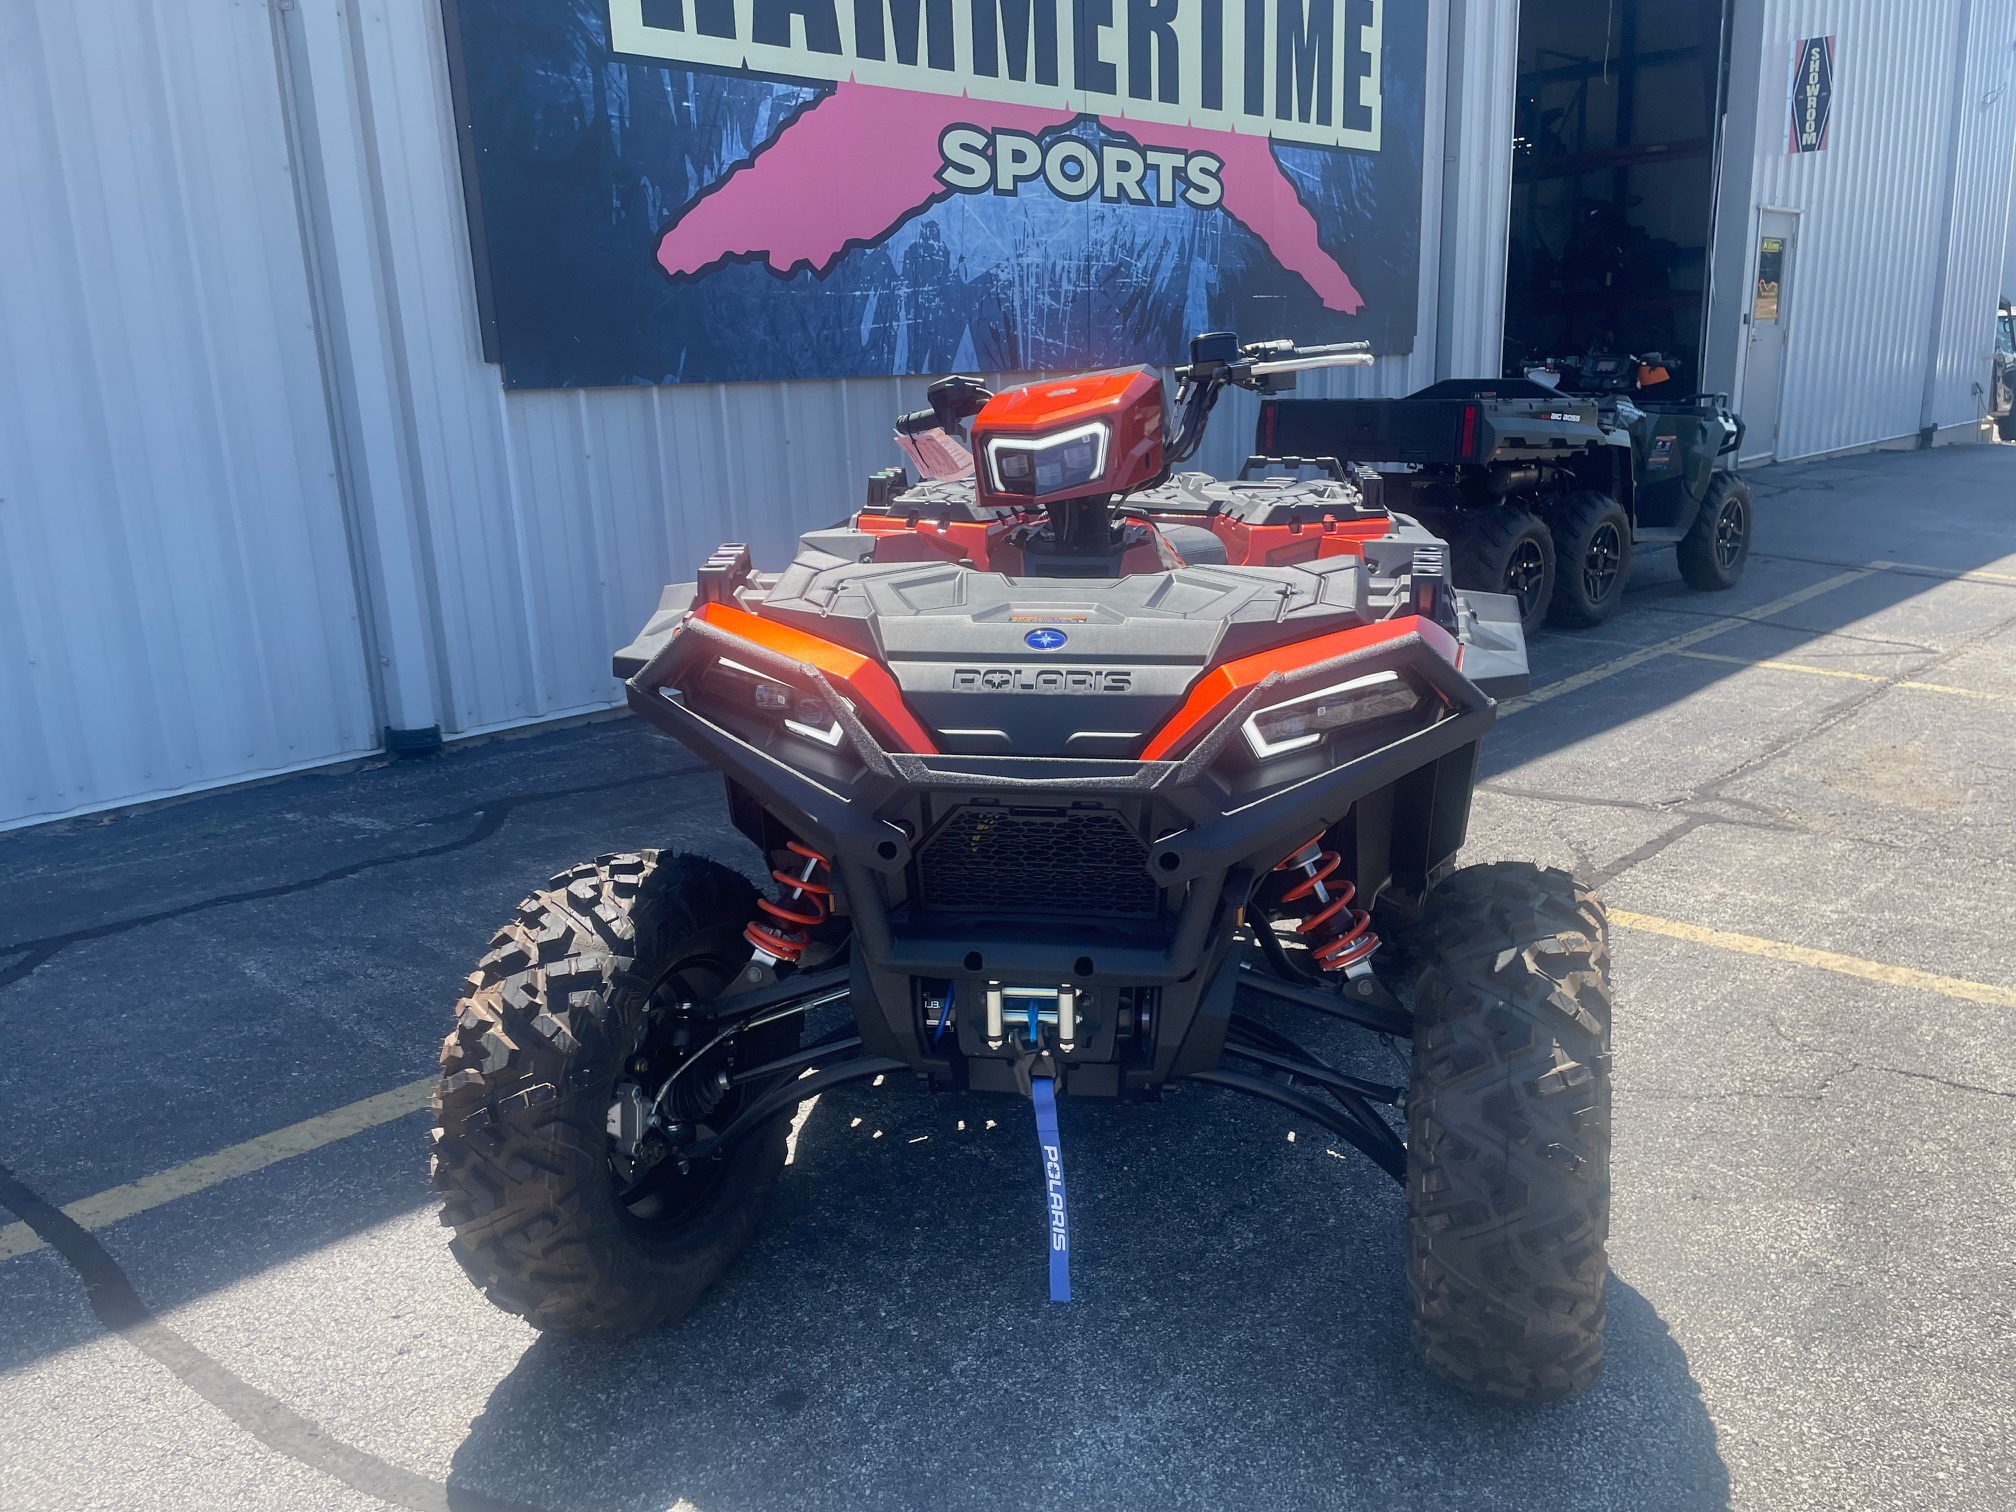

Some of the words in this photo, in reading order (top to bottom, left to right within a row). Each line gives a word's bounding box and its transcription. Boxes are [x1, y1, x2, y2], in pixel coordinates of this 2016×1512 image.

[641, 0, 1374, 132] ERTIME
[1801, 47, 1821, 146] SHOWROOM
[942, 128, 1222, 206] SPORTS
[1550, 412, 1562, 420] BIG
[1562, 413, 1581, 422] BOSS
[952, 668, 1132, 692] POLARIS
[1043, 1145, 1066, 1251] POLARIS
